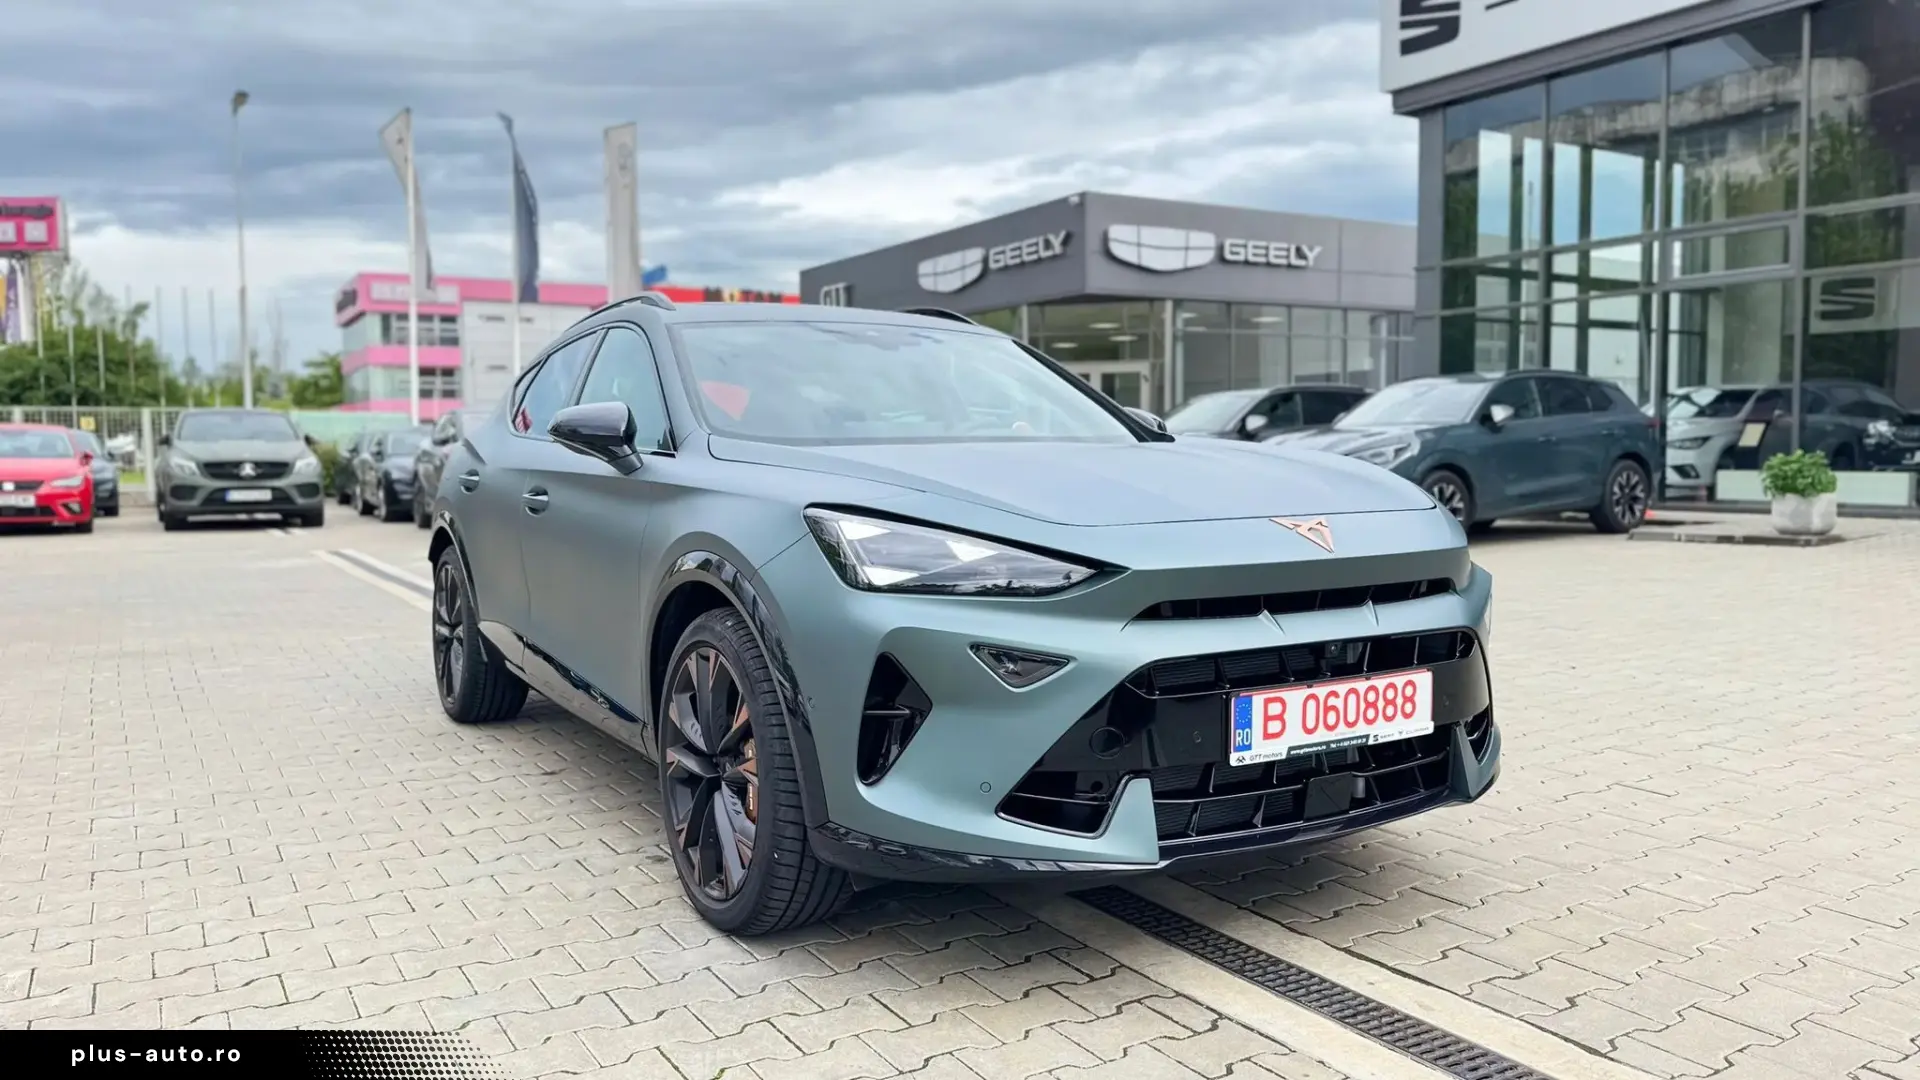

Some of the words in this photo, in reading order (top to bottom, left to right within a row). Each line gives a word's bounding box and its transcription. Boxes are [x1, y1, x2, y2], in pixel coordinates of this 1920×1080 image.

[988, 229, 1068, 270] GEELY
[1222, 238, 1323, 269] GEELY
[1262, 696, 1287, 740] B
[1302, 679, 1416, 735] 060888
[1235, 728, 1251, 746] RO
